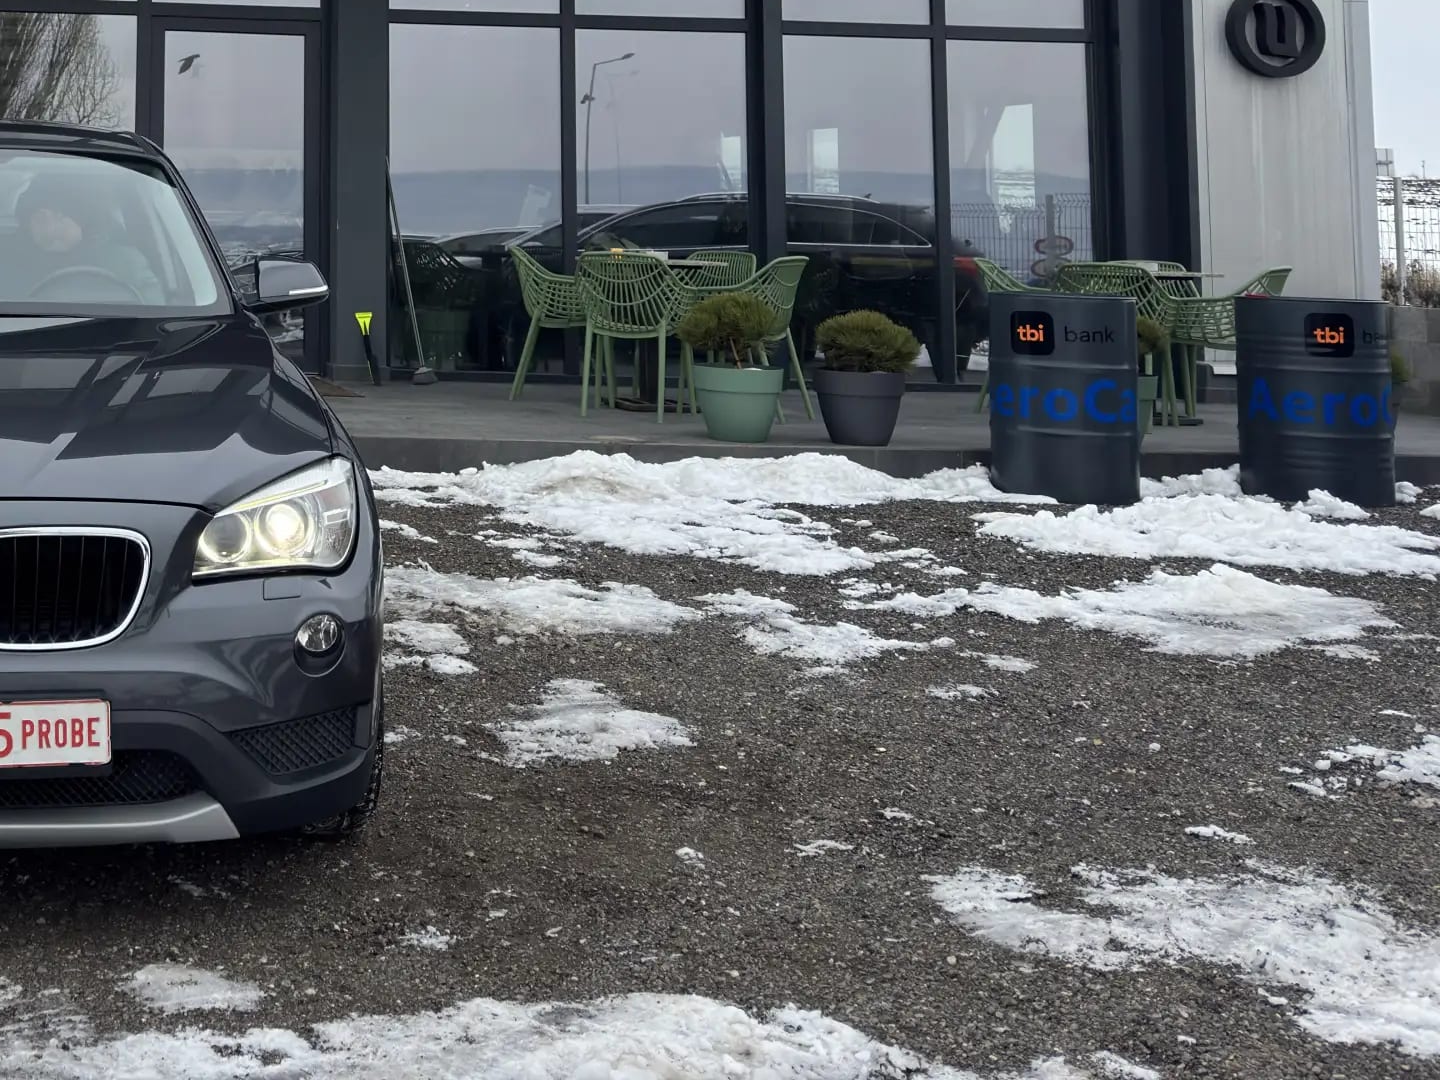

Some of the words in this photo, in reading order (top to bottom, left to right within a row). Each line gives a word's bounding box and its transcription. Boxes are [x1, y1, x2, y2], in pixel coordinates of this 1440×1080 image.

[1017, 324, 1045, 342] tbi
[1064, 326, 1115, 343] bank
[1313, 327, 1344, 344] tbi
[991, 378, 1137, 423] eroCa
[21, 717, 100, 750] PROBE
